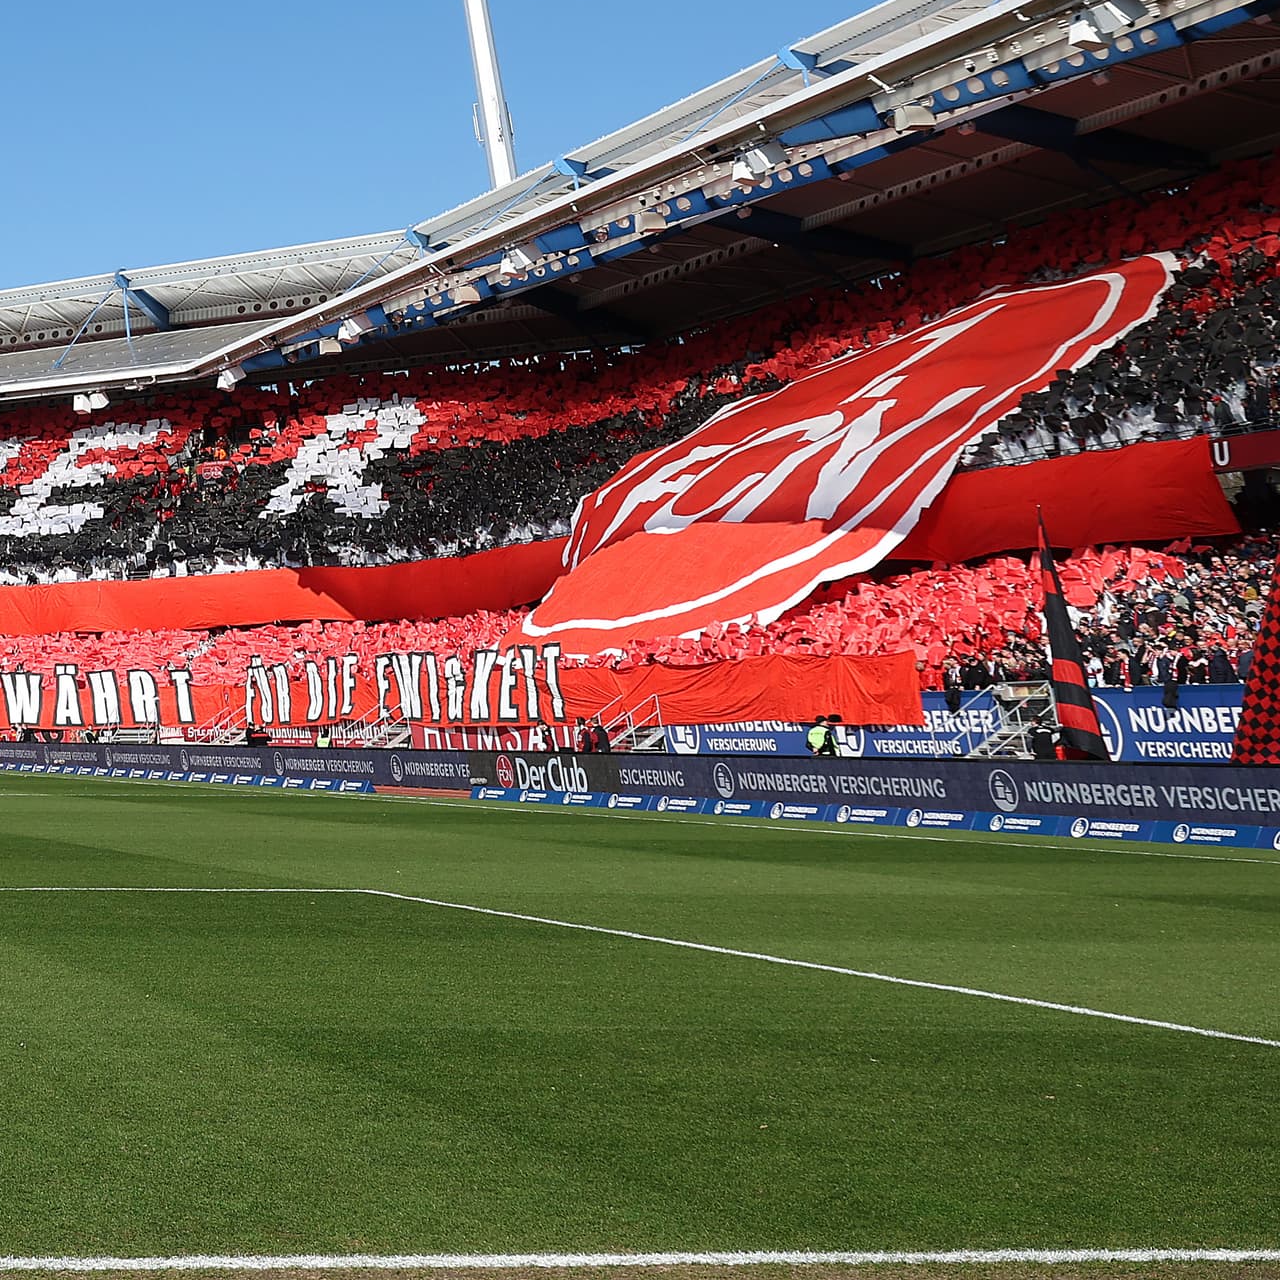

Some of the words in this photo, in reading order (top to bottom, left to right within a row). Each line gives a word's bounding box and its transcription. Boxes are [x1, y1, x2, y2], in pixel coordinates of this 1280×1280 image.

[0, 663, 195, 726] WÄHRT
[304, 652, 358, 720] DIE
[375, 642, 566, 722] EWIGKEIT
[707, 738, 777, 751] VERSICHERUNG
[873, 739, 962, 755] VERSICHERUNG
[189, 755, 221, 768] NÜRNBERGER
[222, 757, 261, 769] VERSICHERUNG
[284, 757, 325, 772] NÜRNBERGER
[326, 759, 375, 774] VERSICHERUNG
[404, 760, 455, 777] NÜRNBERGER
[738, 771, 828, 794] NÜRNBERGER
[831, 775, 946, 798] VERSICHERUNG
[1024, 780, 1158, 808] NÜRNBERGER
